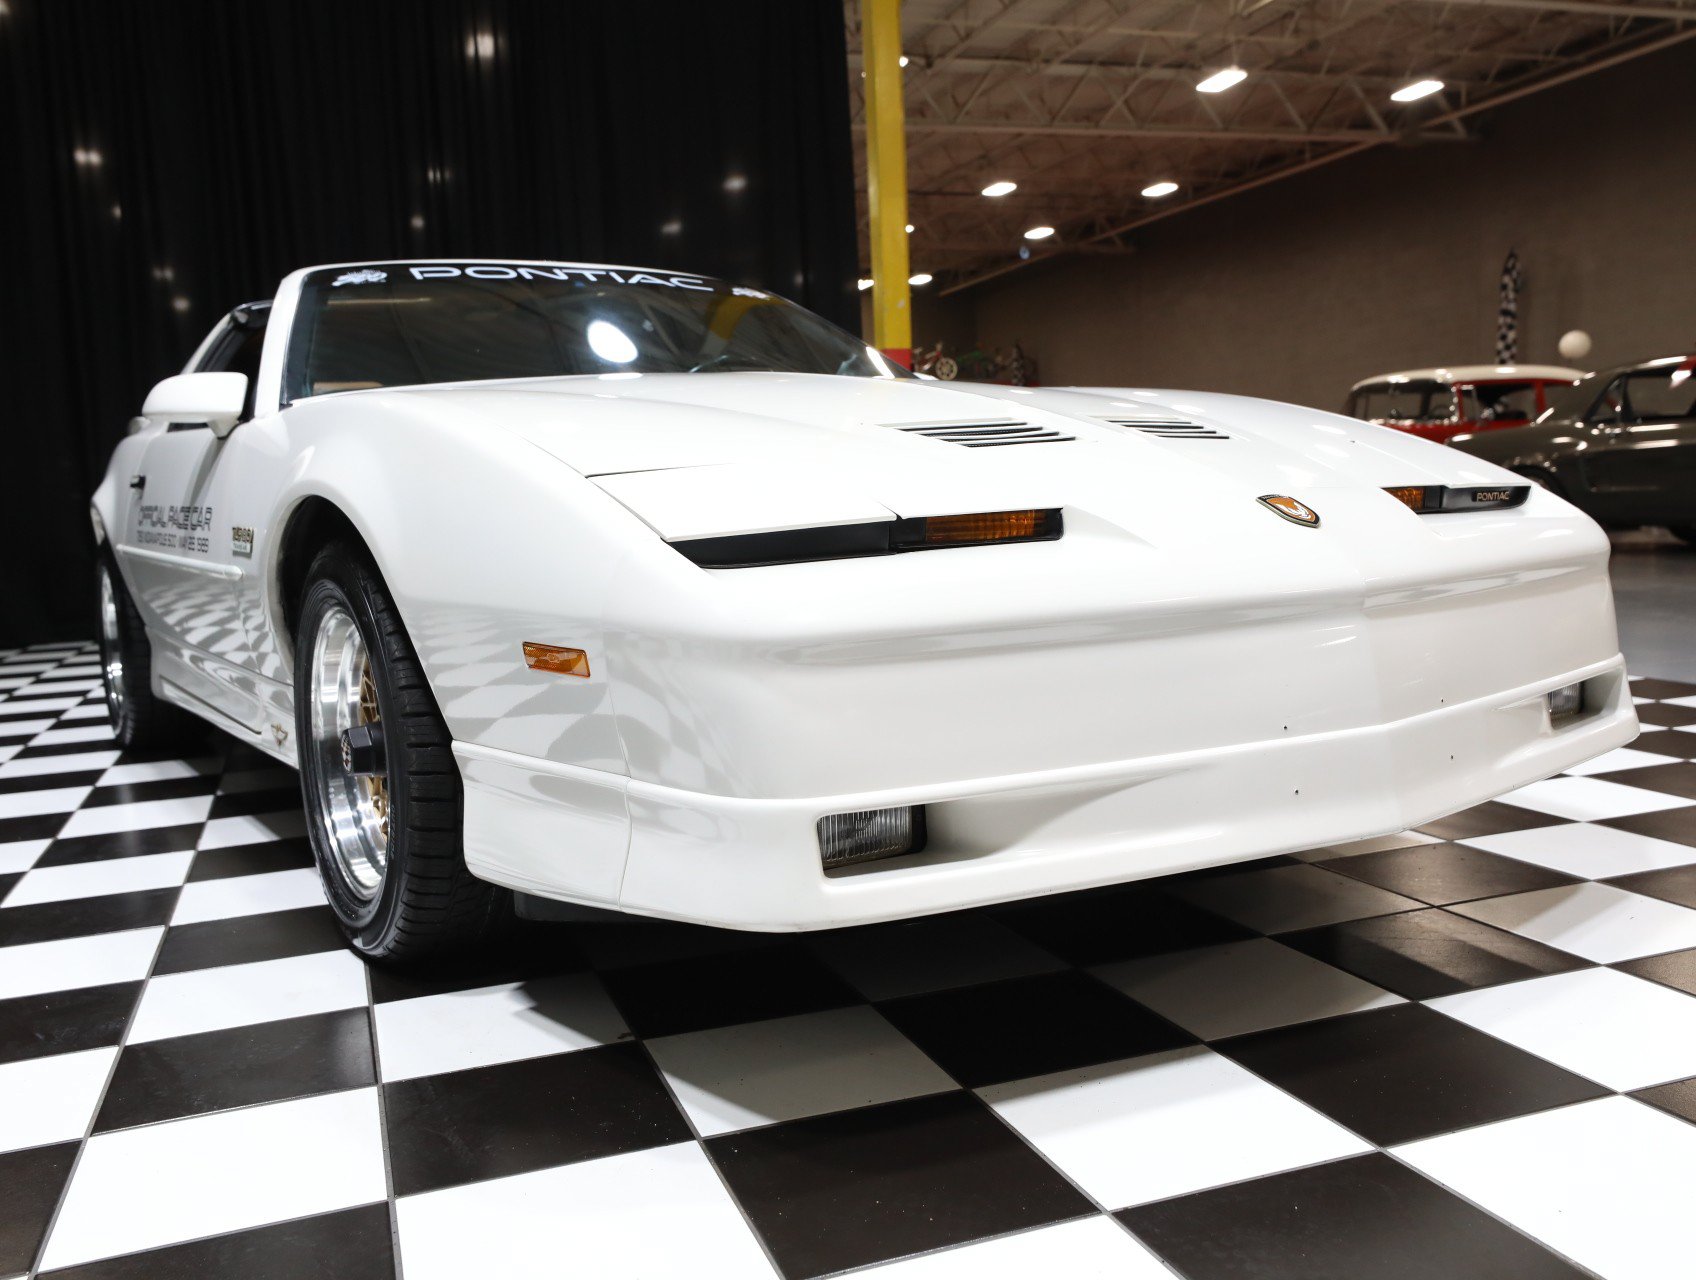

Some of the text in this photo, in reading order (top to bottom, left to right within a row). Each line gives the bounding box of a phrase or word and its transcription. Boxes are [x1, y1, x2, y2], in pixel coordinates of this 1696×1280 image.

[409, 266, 714, 291] PONTIAC
[1476, 491, 1510, 502] PONTIAC
[190, 507, 213, 532] CAR
